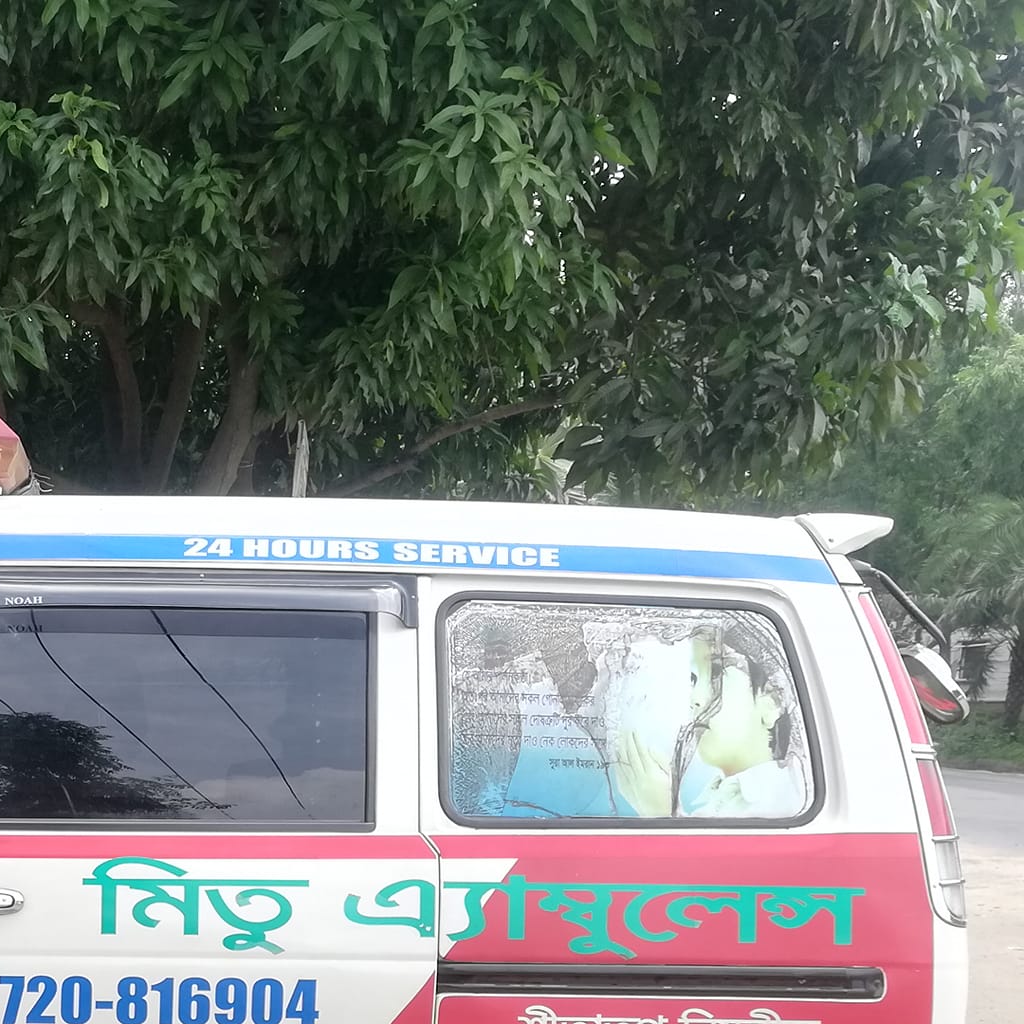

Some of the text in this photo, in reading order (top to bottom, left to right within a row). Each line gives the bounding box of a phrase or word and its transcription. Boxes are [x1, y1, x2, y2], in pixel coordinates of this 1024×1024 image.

[183, 538, 560, 568] 24 HOURS SERVICE
[5, 596, 43, 606] NOAH
[7, 624, 43, 633] NOAH
[82, 856, 864, 961] মিতু এ্যাম্বুলেন্স
